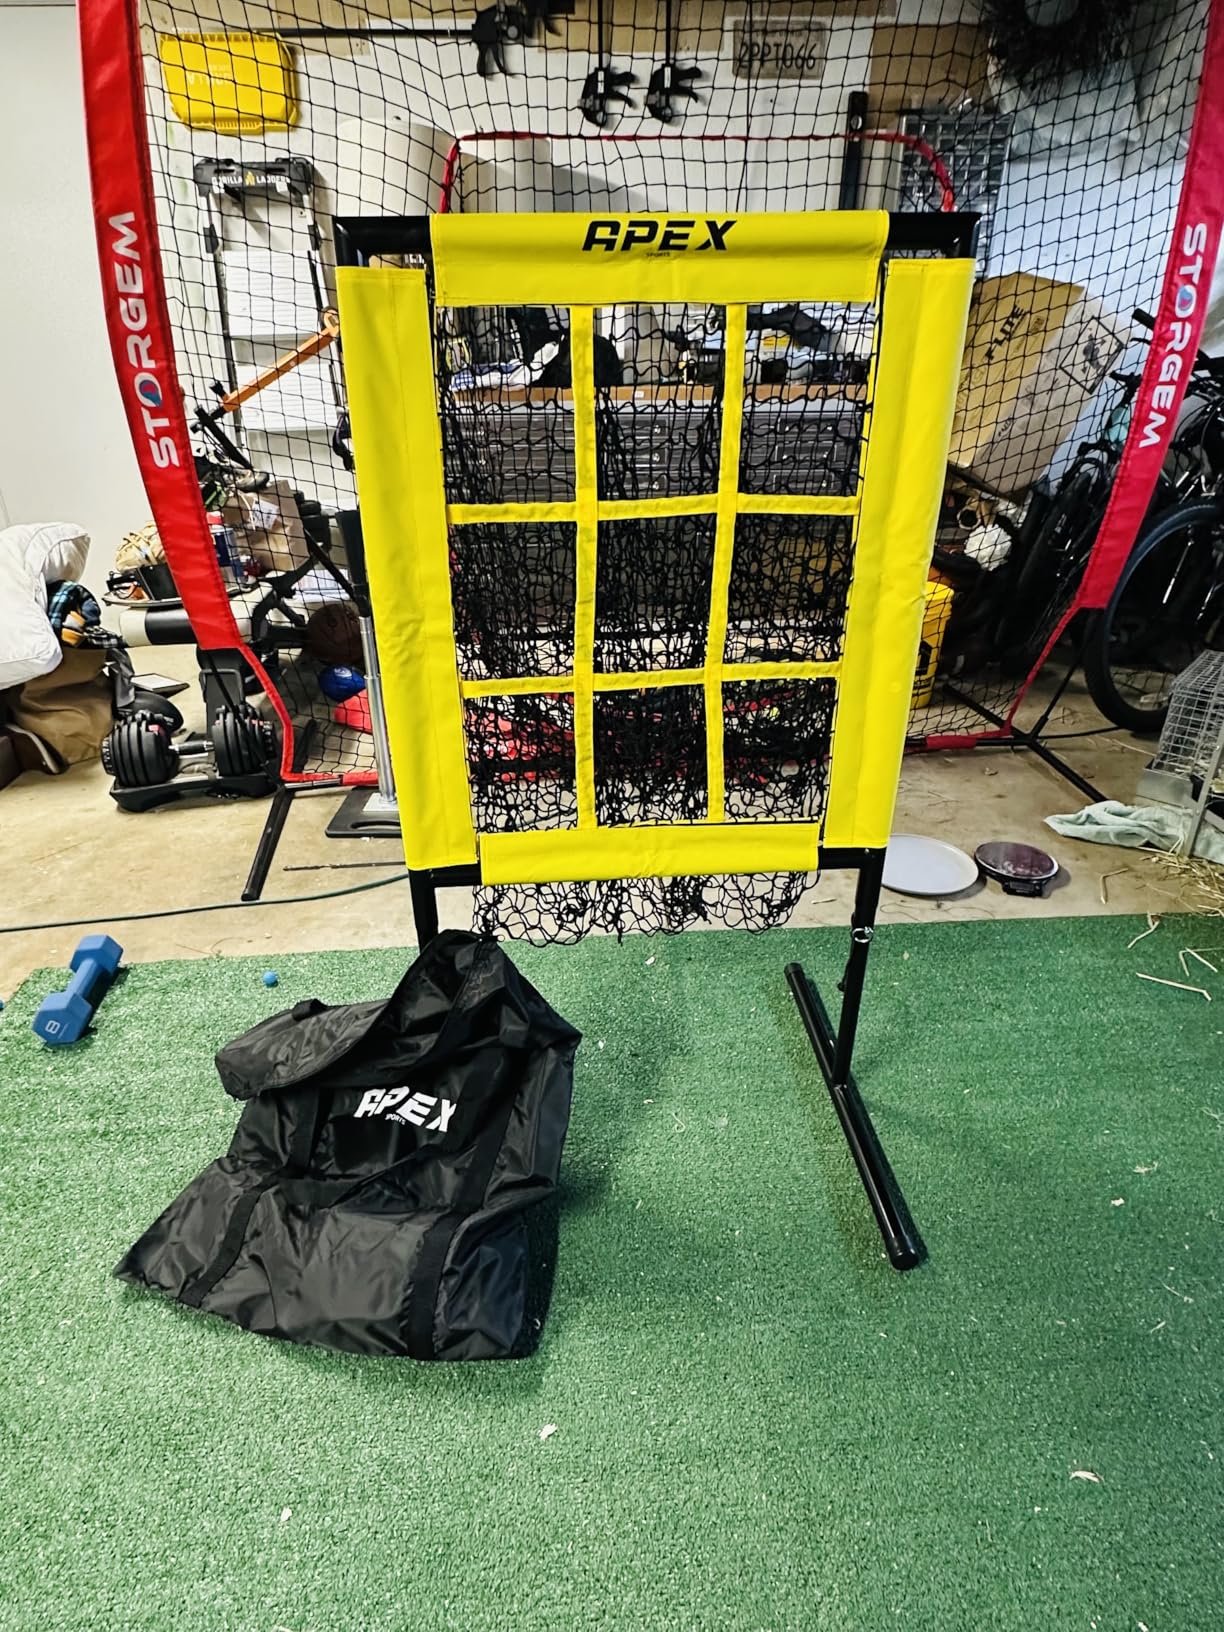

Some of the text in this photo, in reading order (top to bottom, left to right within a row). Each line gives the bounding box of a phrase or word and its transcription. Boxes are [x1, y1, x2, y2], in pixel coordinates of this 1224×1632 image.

[582, 219, 738, 252] APEX
[108, 211, 181, 468] STORGEM
[1138, 222, 1208, 448] STORGEM
[45, 1020, 61, 1034] 8
[353, 1085, 457, 1133] APEX
[385, 1112, 406, 1126] SPORTS
